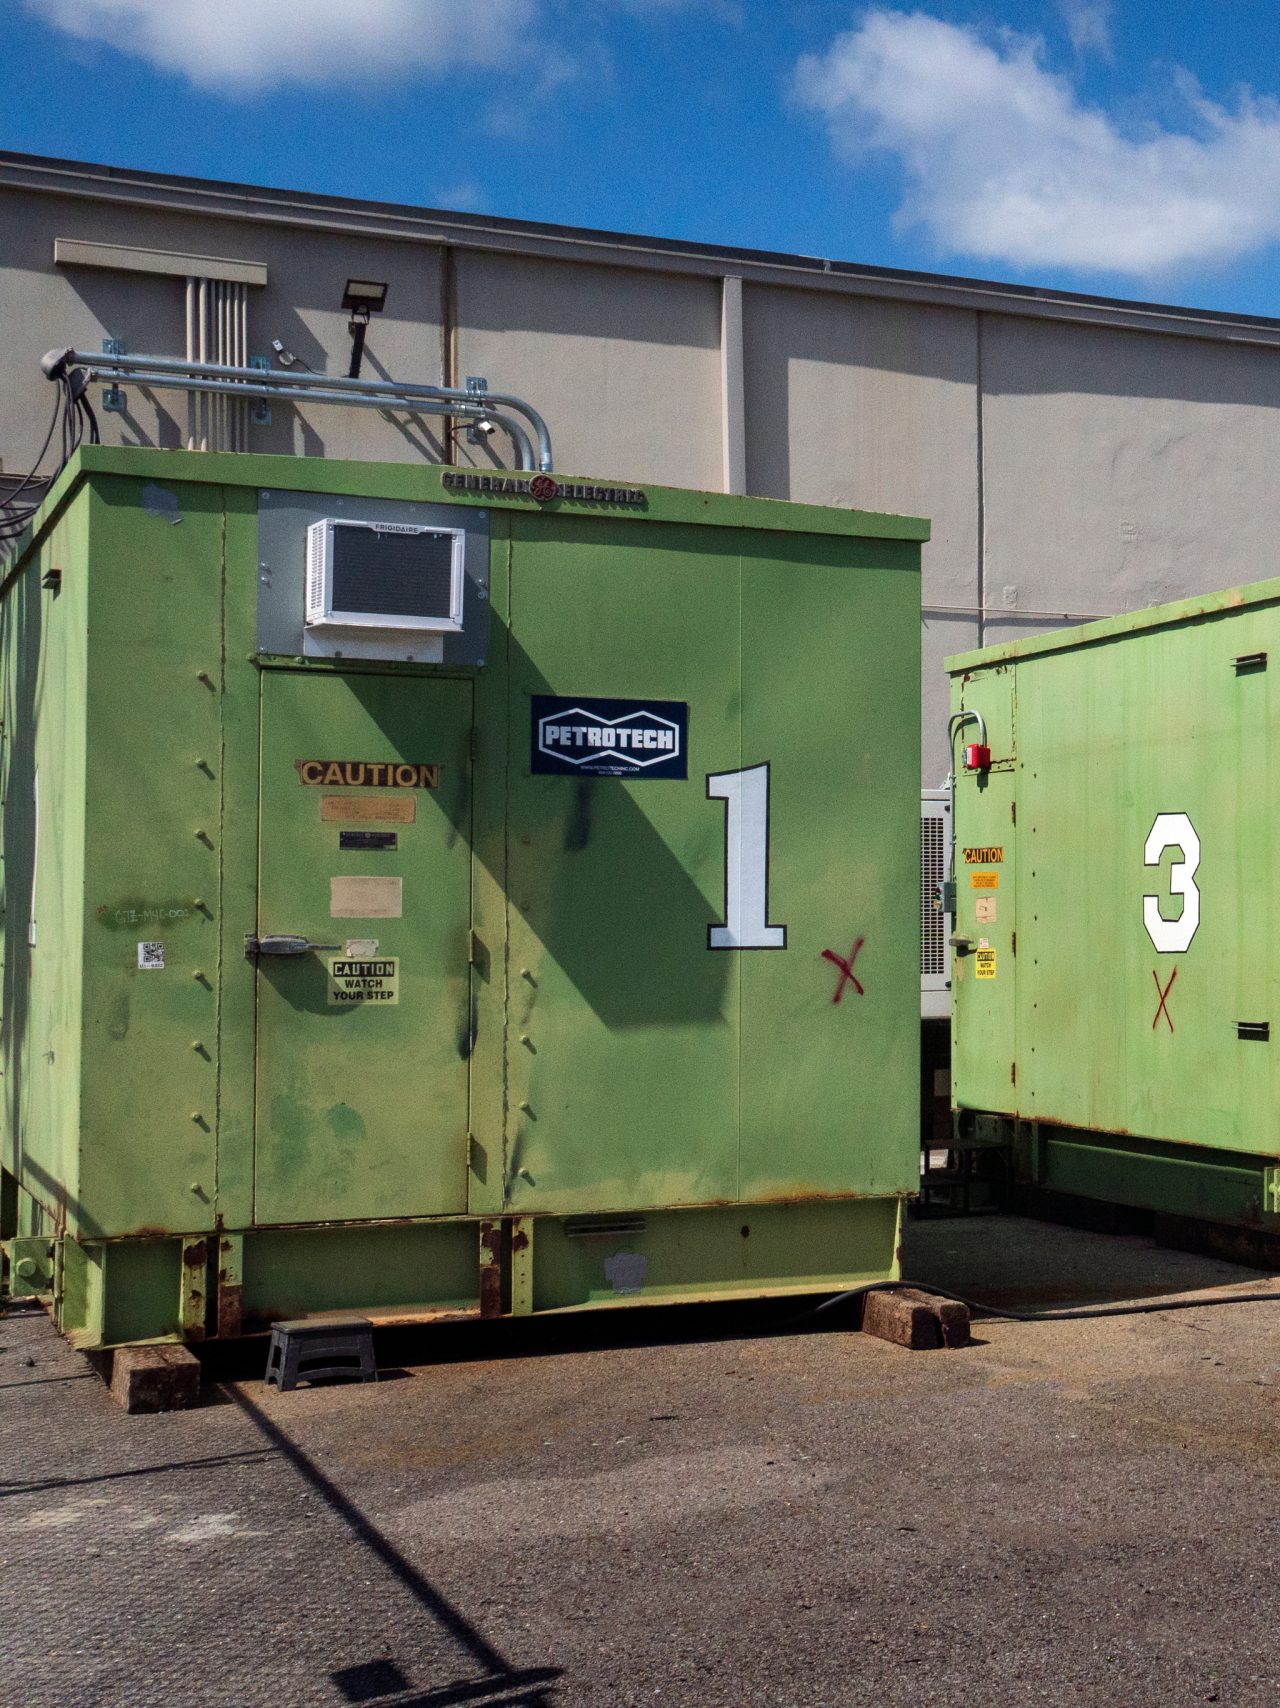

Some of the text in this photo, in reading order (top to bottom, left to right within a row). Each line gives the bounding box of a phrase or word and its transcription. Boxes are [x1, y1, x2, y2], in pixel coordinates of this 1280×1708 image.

[441, 471, 527, 493] GENERAL
[563, 483, 645, 503] ELECTRIC
[375, 523, 419, 534] FRIGIDAIRE
[545, 725, 674, 750] PETROTECH
[302, 761, 438, 788] CAUTION
[705, 760, 788, 951] 1
[963, 848, 1004, 863] CAUTION
[1142, 811, 1201, 954] 3
[977, 952, 995, 961] CAUTION
[334, 963, 394, 976] CAUTION
[345, 979, 383, 988] WATCH
[333, 991, 394, 1001] YOUR STEP
